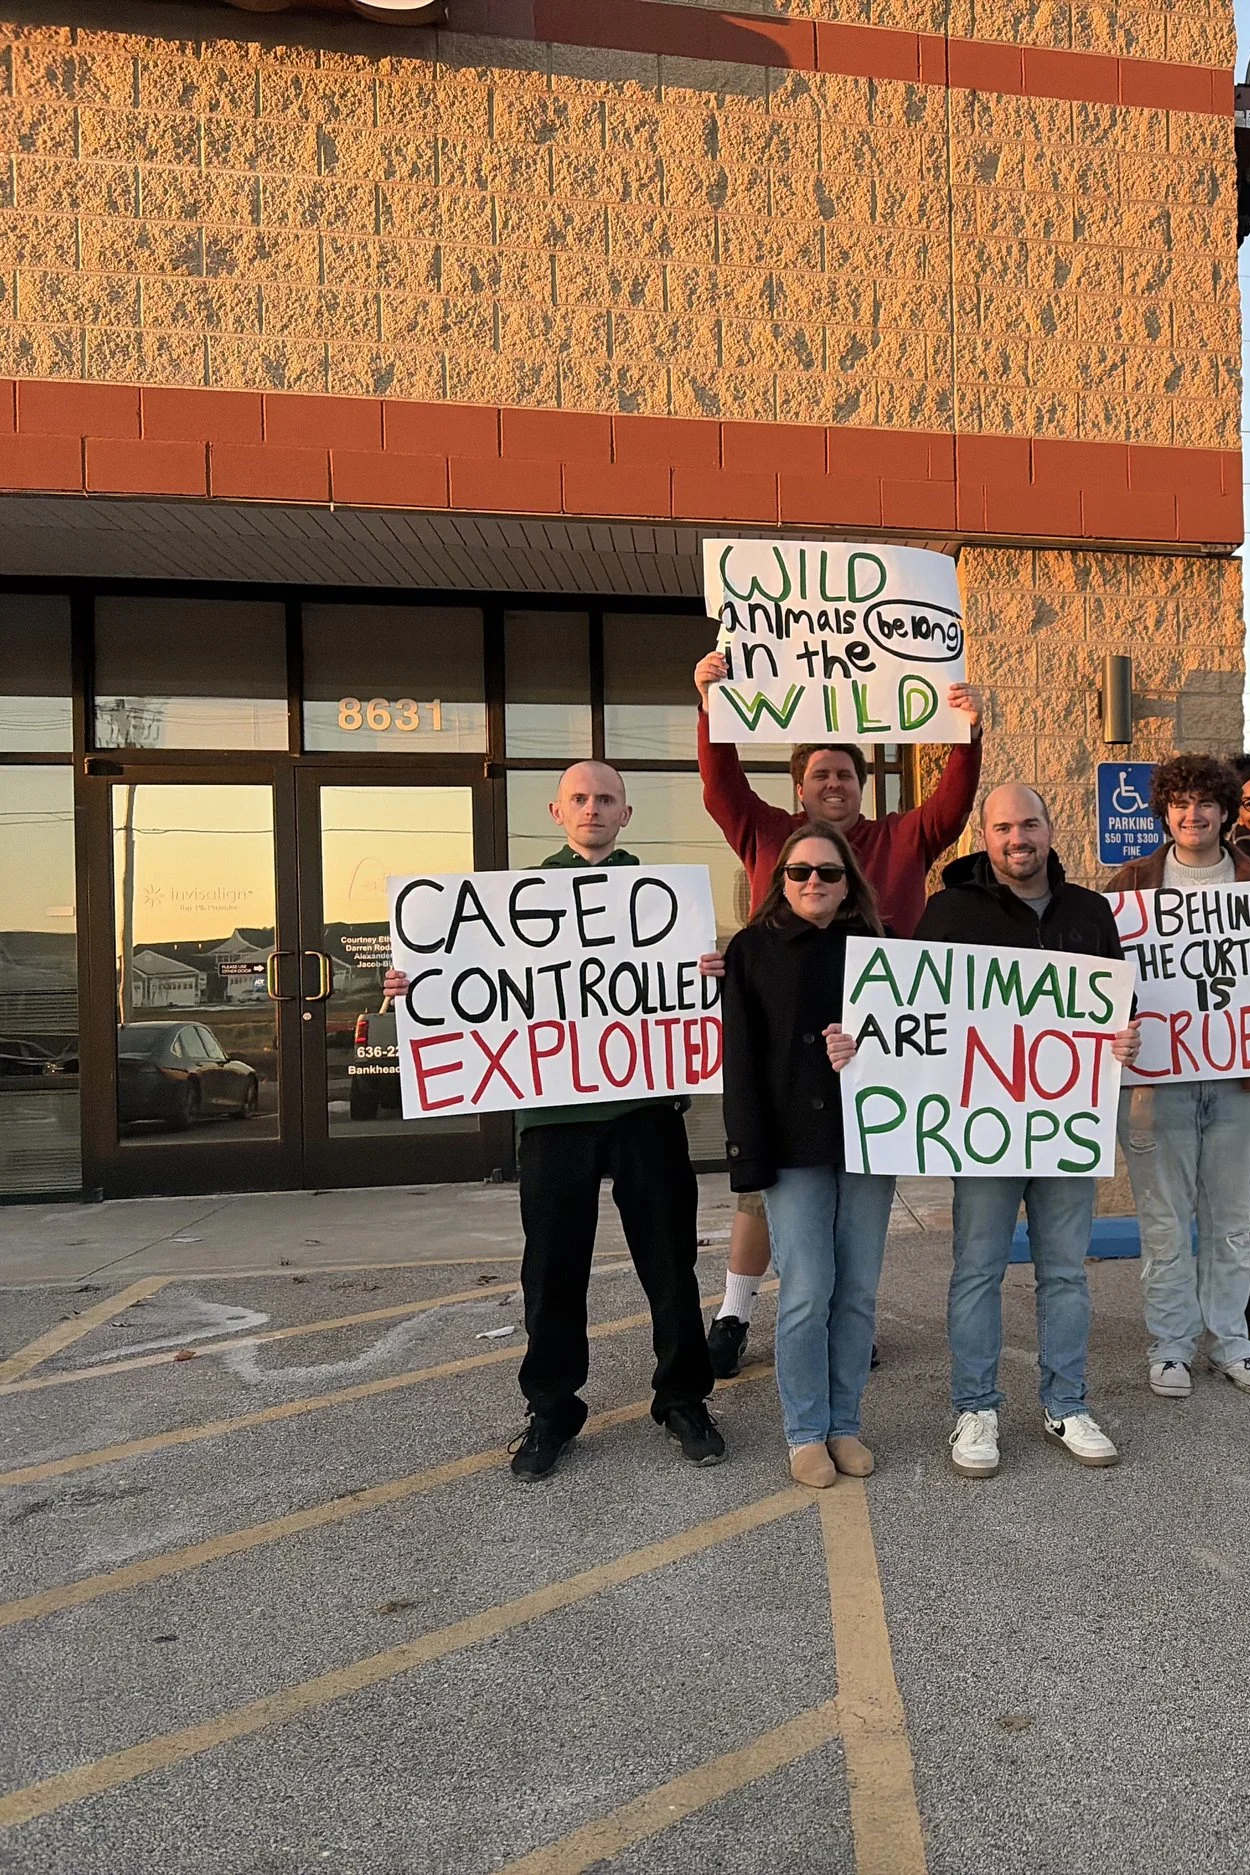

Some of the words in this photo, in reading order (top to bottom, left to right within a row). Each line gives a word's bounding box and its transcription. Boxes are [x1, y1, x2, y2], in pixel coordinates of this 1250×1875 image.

[719, 545, 887, 603] WILD
[718, 600, 857, 640] animals
[725, 640, 779, 680] in
[796, 639, 877, 680] the
[338, 697, 443, 731] 8631
[719, 674, 939, 734] WILD
[1104, 832, 1121, 844] $50
[1123, 832, 1135, 844] TO
[1137, 832, 1159, 844] $300
[1108, 816, 1154, 830] PARKING
[1122, 845, 1142, 856] FINE
[395, 873, 678, 954] CAGED
[340, 936, 377, 945] Courtney
[345, 944, 373, 952] Darren
[374, 943, 392, 951] Rod
[357, 960, 380, 968] Jacob
[405, 957, 721, 1026] CONTROLLED
[849, 947, 1114, 1025] ANIMALS
[1196, 976, 1237, 1012] IS
[409, 1016, 723, 1112] EXPLOITED
[855, 1013, 948, 1058] ARE
[959, 1023, 1117, 1108] NOT
[855, 1085, 1101, 1175] PROPS
